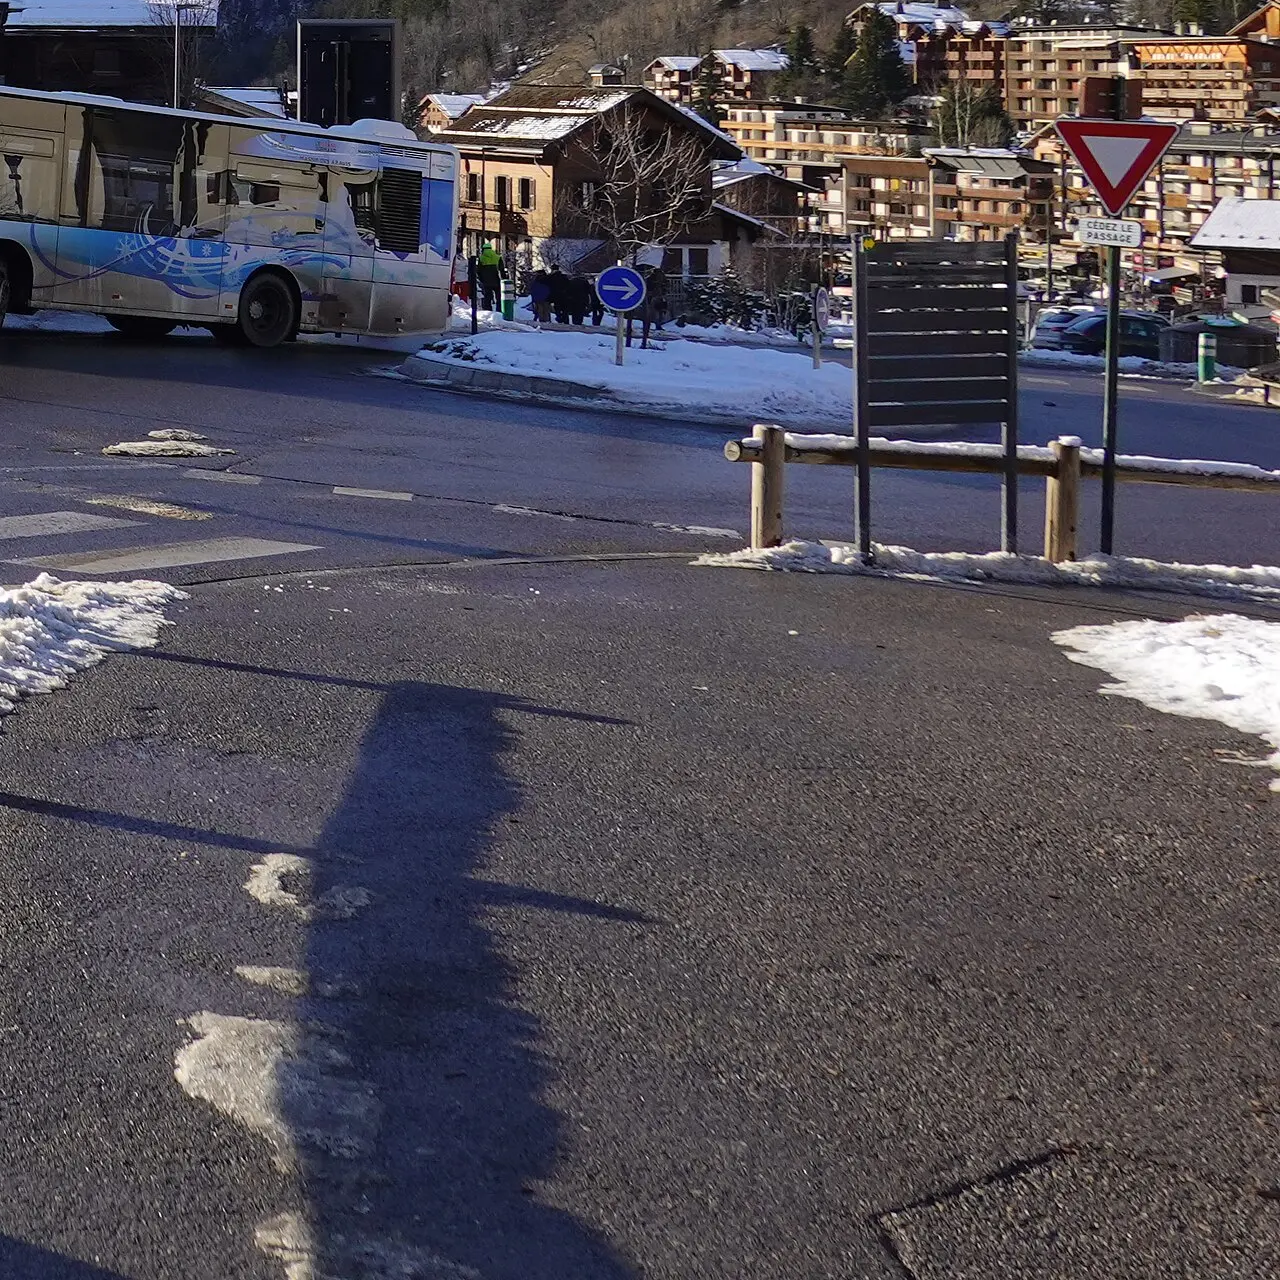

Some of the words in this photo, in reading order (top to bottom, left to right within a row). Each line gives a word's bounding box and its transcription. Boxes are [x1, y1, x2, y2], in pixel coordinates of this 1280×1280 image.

[1086, 220, 1117, 231] CÉDEZ
[1121, 224, 1133, 233] LE
[1086, 231, 1132, 243] PASSAGE
